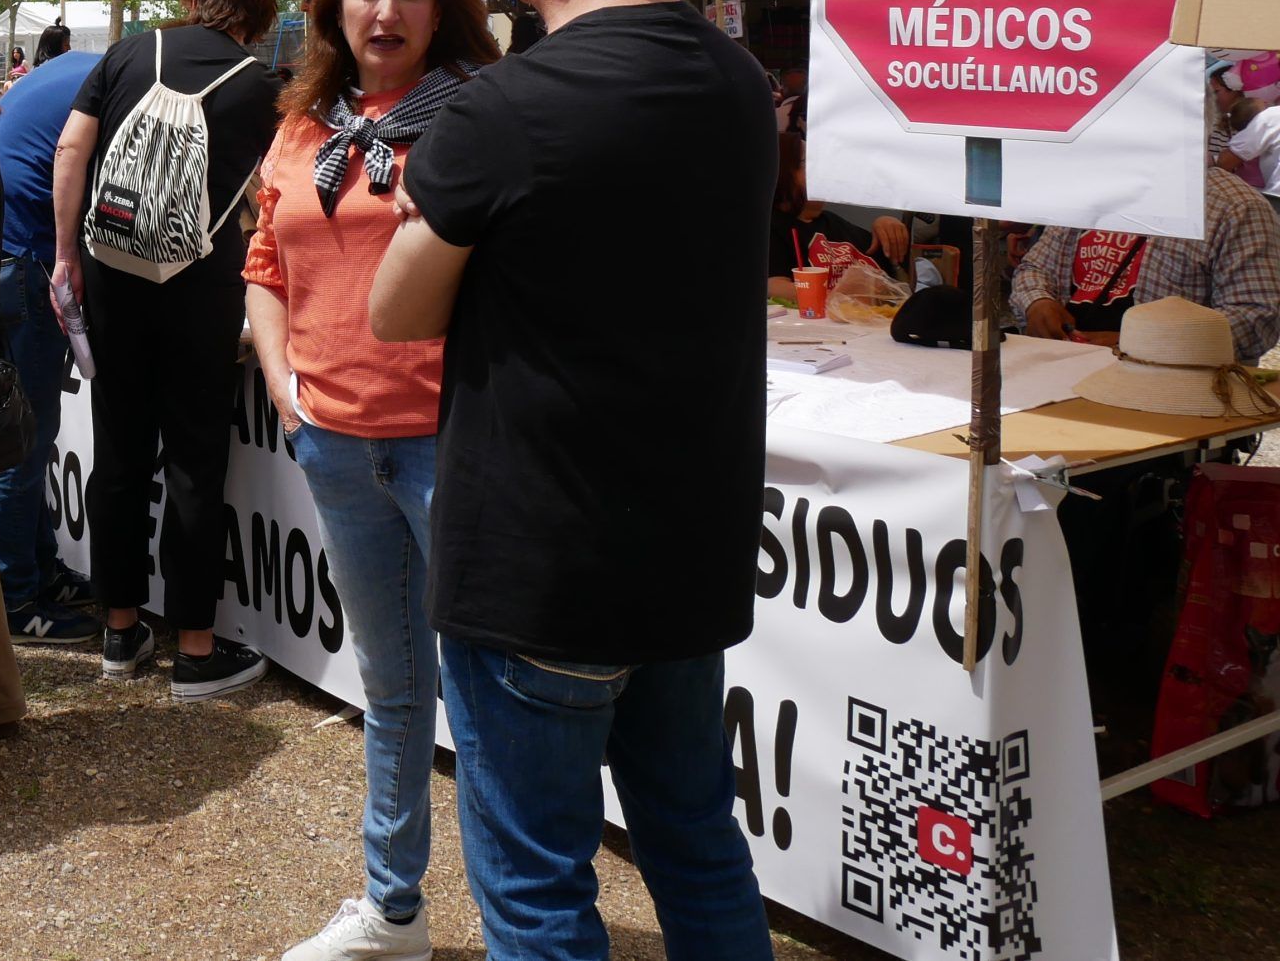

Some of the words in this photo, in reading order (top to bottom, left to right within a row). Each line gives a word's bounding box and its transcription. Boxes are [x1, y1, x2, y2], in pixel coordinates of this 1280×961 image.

[887, 56, 1098, 96] SOCUÉLLAMOS
[113, 195, 134, 209] ZEBRA
[755, 486, 1024, 667] SIDUOS
